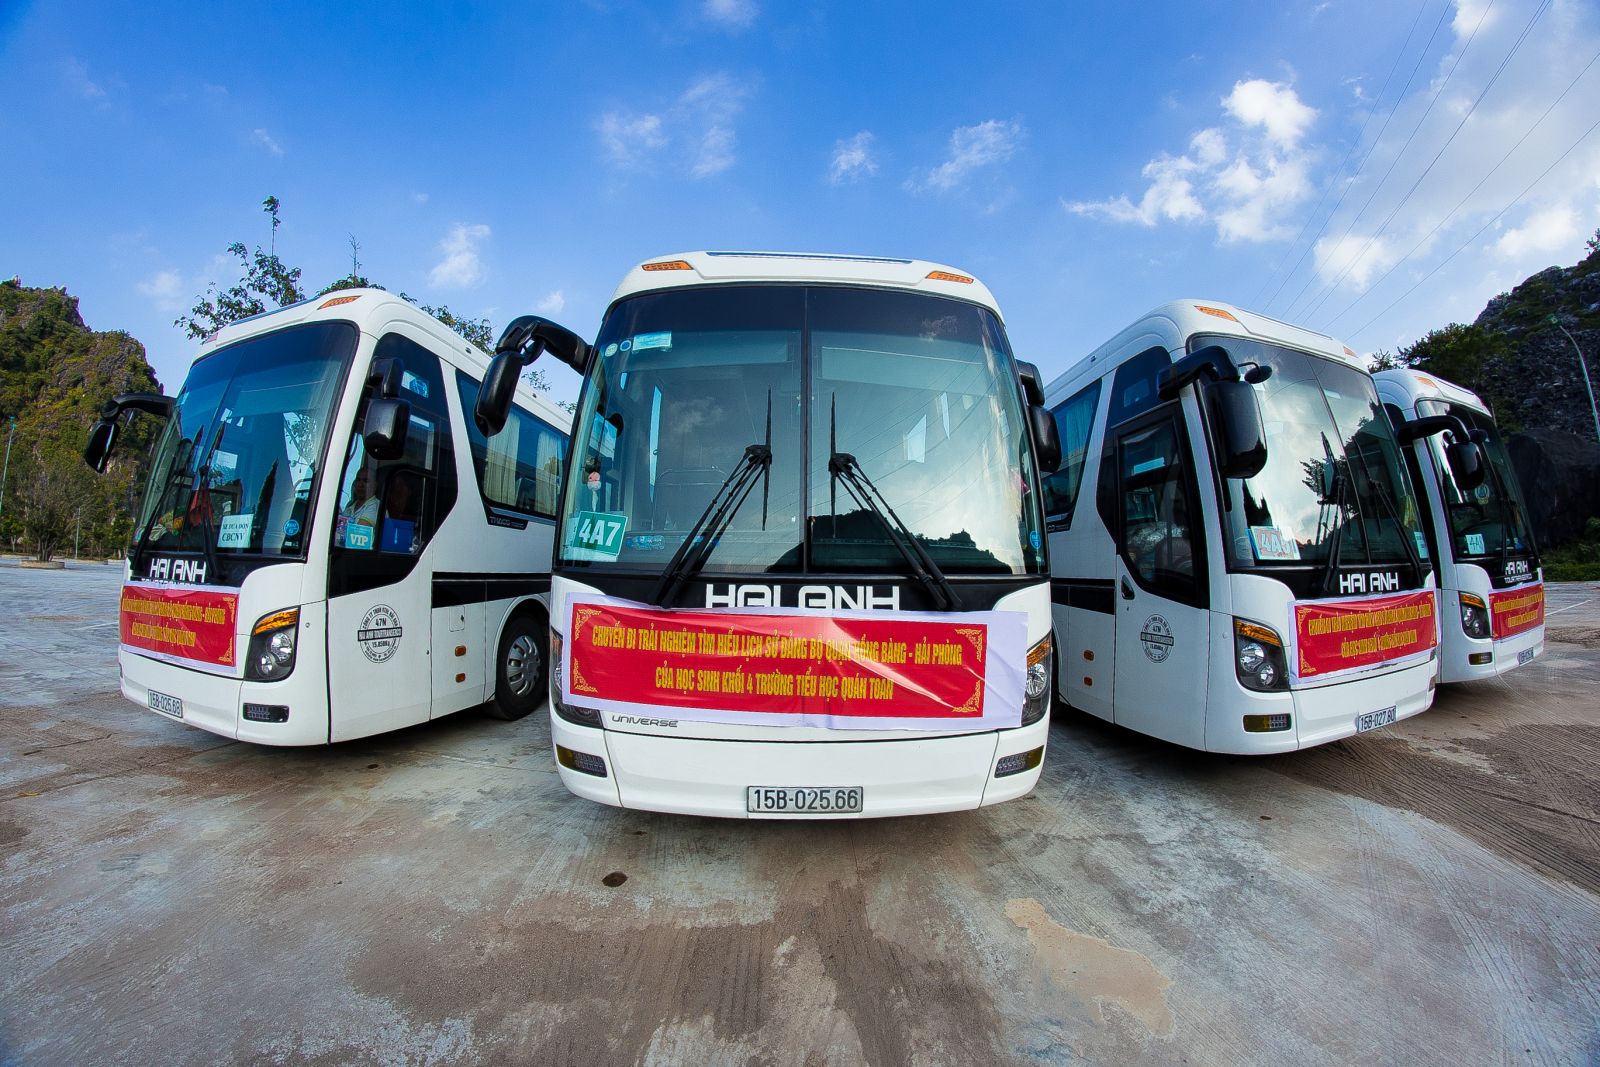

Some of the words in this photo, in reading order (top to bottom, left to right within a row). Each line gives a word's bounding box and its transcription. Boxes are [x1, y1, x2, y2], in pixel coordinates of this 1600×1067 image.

[350, 533, 369, 546] VIP
[579, 518, 622, 547] 4A7
[150, 558, 172, 579] HAI
[172, 559, 207, 583] ANH
[1339, 573, 1366, 594] HAI
[1370, 572, 1399, 591] ANH
[705, 584, 781, 609] HAI
[798, 585, 900, 610] ANH
[592, 621, 626, 648] CHUYẾN
[626, 627, 636, 649] ĐI
[638, 623, 658, 651] TRẢI
[660, 627, 696, 658] NGHIỆM
[698, 629, 715, 655] TÌM
[718, 624, 739, 656] HIỂU
[741, 634, 762, 662] LỊCH
[765, 629, 779, 657] SỬ
[780, 630, 808, 659] ĐẢNG
[810, 633, 823, 665] BỘ
[881, 637, 907, 664] BÀNG
[915, 636, 930, 664] HẢI
[932, 639, 963, 666] PHÒNG
[655, 660, 674, 689] CỦA
[676, 668, 695, 695] HỌC
[697, 669, 720, 692] SINH
[722, 664, 744, 694] KHỐI
[746, 672, 753, 694] 4
[756, 668, 794, 696] TRƯỜNG
[796, 666, 817, 697] TIỂU
[819, 675, 839, 702] HỌC
[841, 673, 867, 701] QUÁN
[869, 678, 894, 700] TOAN
[612, 715, 679, 727] UNIVERSE
[754, 789, 859, 810] 15B-025.66
